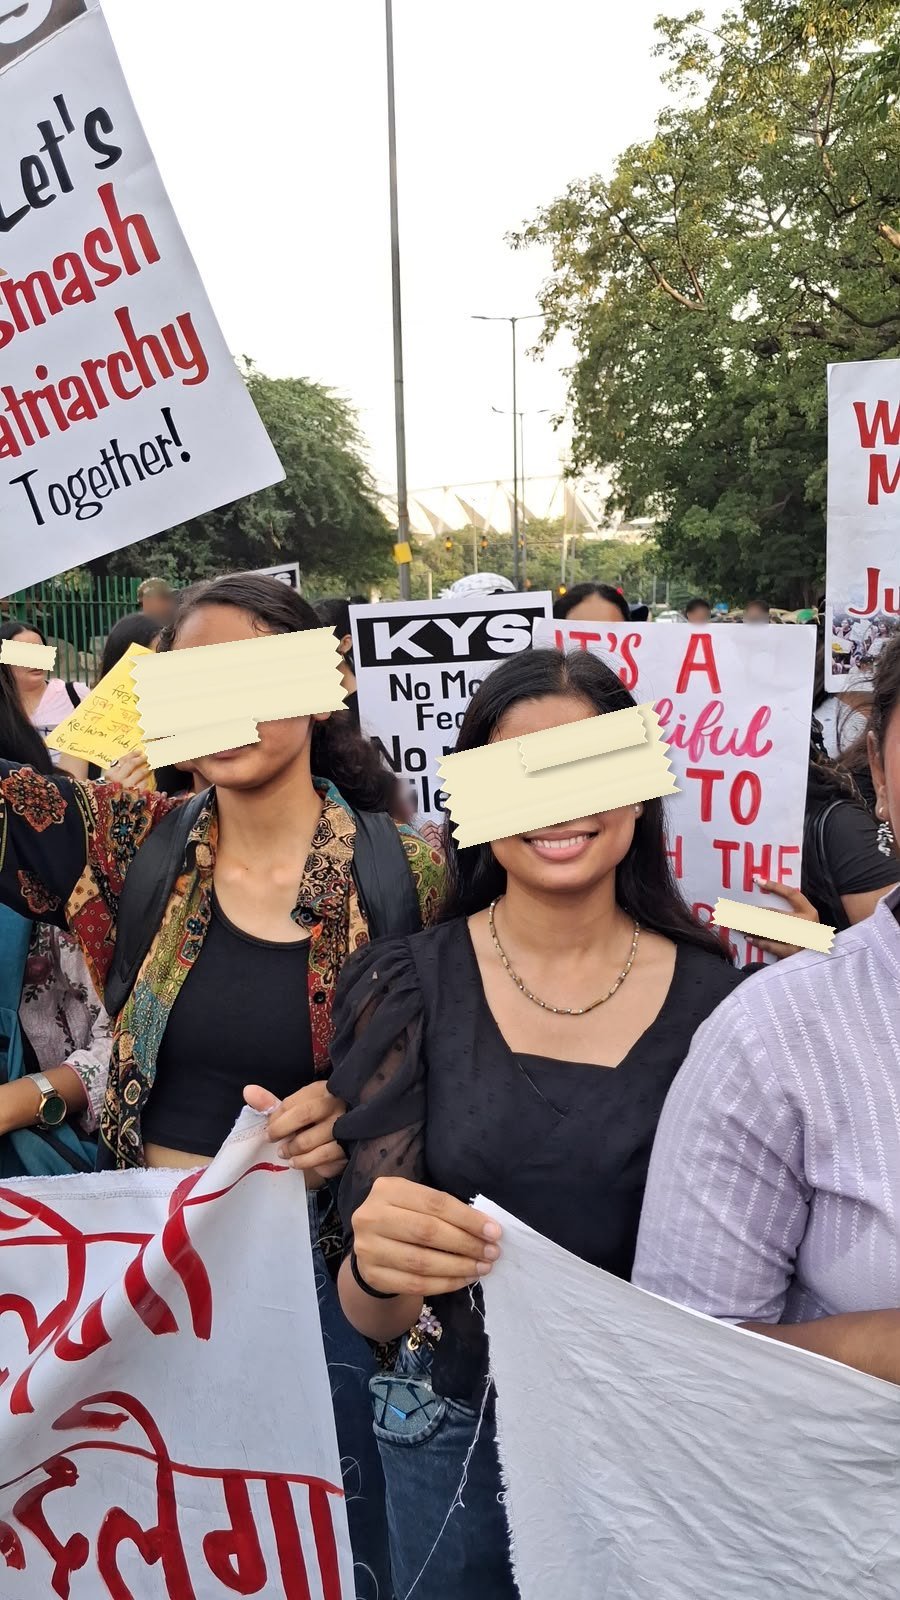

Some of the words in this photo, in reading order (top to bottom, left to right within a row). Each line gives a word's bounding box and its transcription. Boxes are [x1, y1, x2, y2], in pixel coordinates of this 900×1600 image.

[0, 182, 161, 349] mash
[0, 306, 209, 459] atriarchy
[9, 407, 191, 525] Together!
[389, 673, 430, 701] No
[441, 670, 483, 699] Mo
[676, 634, 721, 693] A
[67, 718, 107, 738] Reclaim
[112, 734, 138, 752] Publ
[371, 735, 427, 772] No
[686, 768, 761, 826] TO
[713, 839, 800, 894] THE
